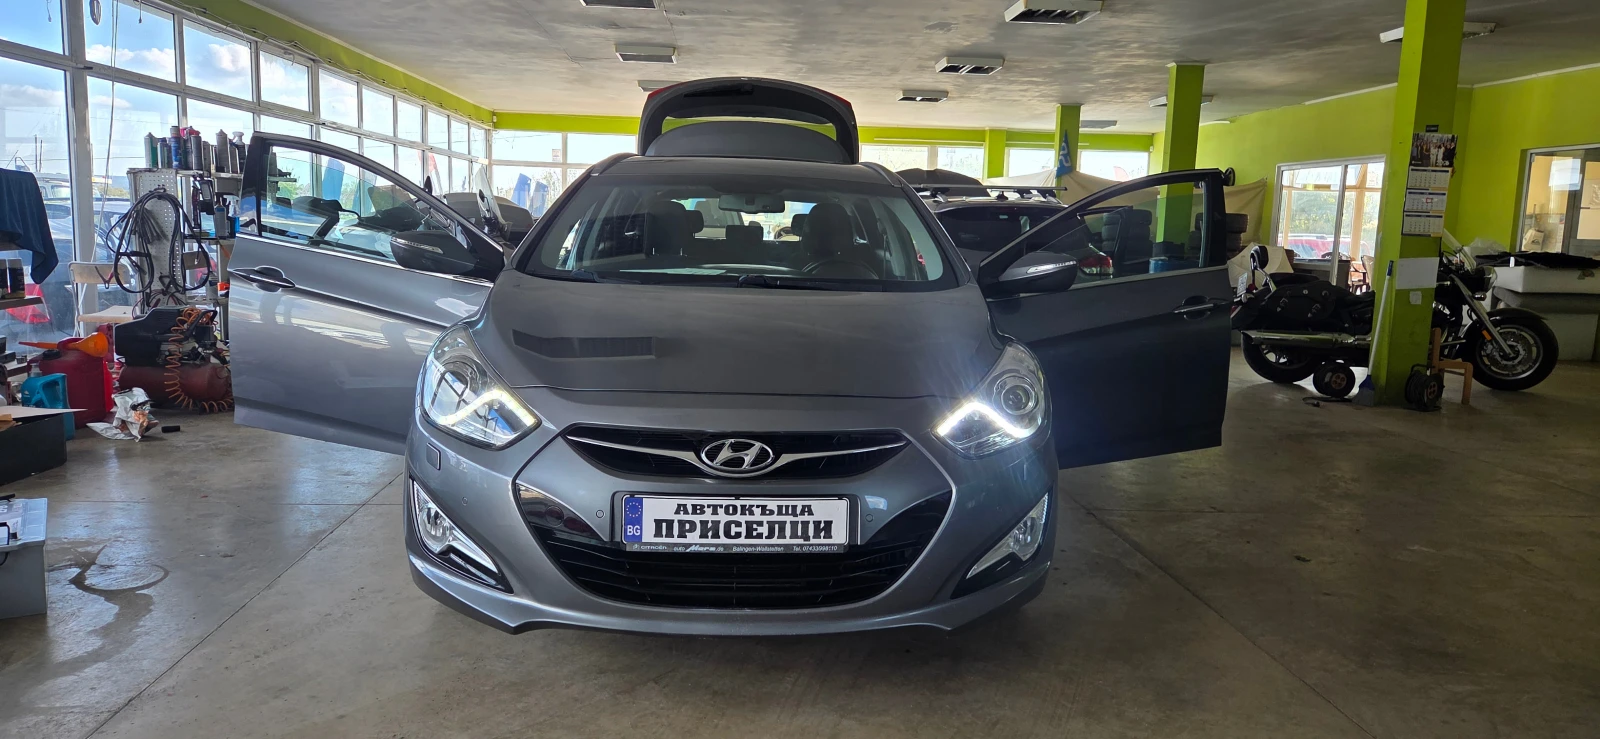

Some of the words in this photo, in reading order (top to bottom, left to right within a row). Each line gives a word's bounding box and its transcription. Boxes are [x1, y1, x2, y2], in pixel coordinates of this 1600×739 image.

[674, 503, 815, 517] АВТОКЪЩА
[627, 525, 641, 536] BG
[653, 518, 833, 542] ПРИСЕЛЦИ
